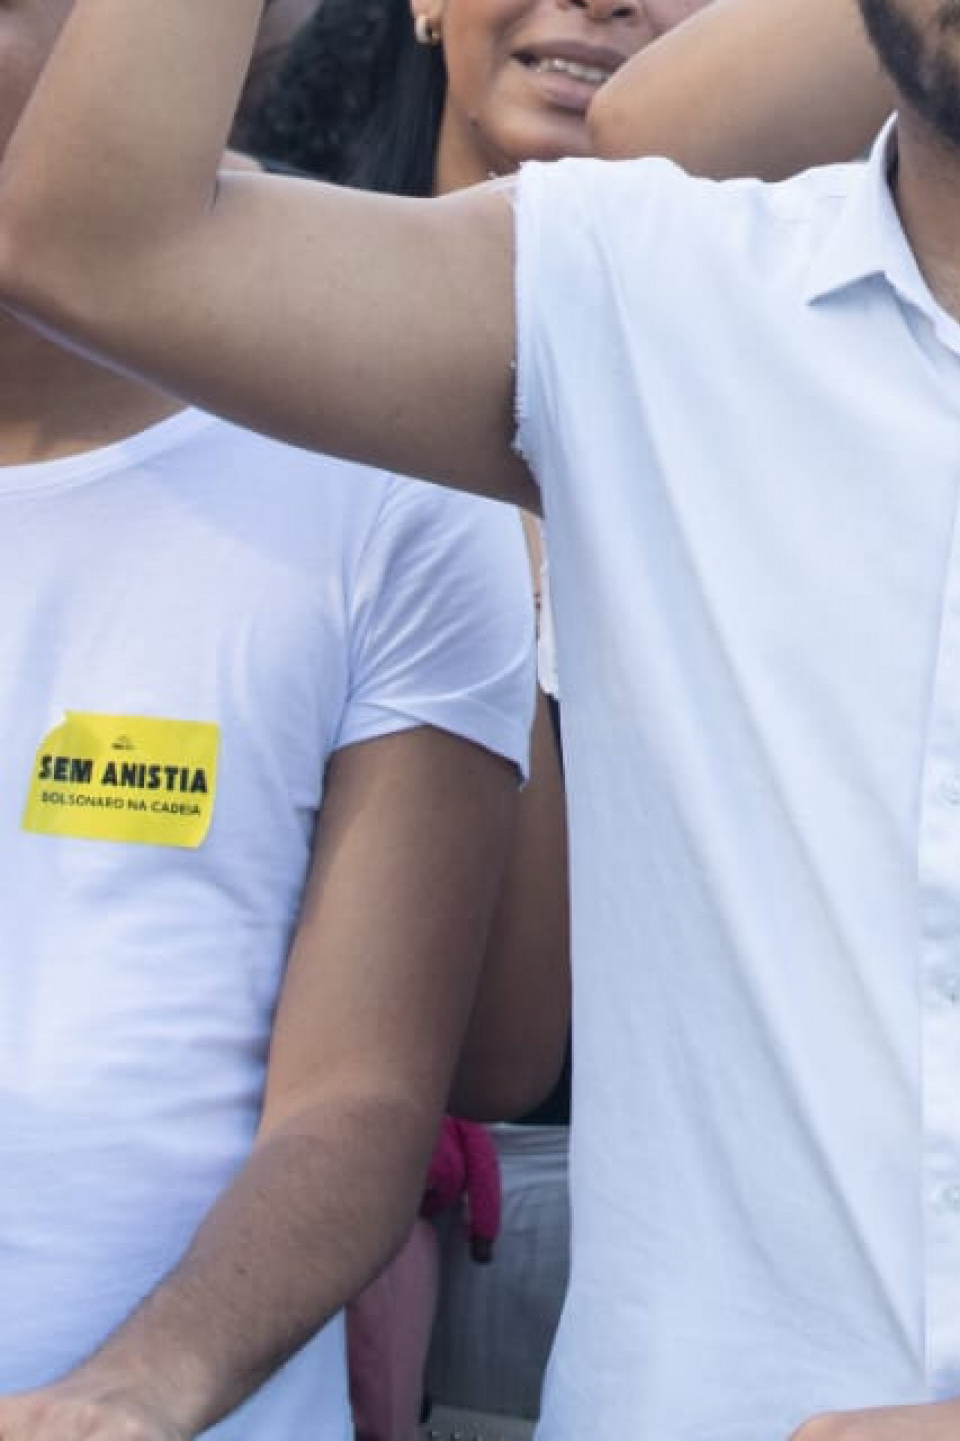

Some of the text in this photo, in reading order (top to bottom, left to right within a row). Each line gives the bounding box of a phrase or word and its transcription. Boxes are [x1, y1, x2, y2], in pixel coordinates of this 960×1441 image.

[38, 755, 208, 793] SEM ANISTIA
[42, 791, 124, 809] BOLSONARO
[128, 798, 146, 811] NA
